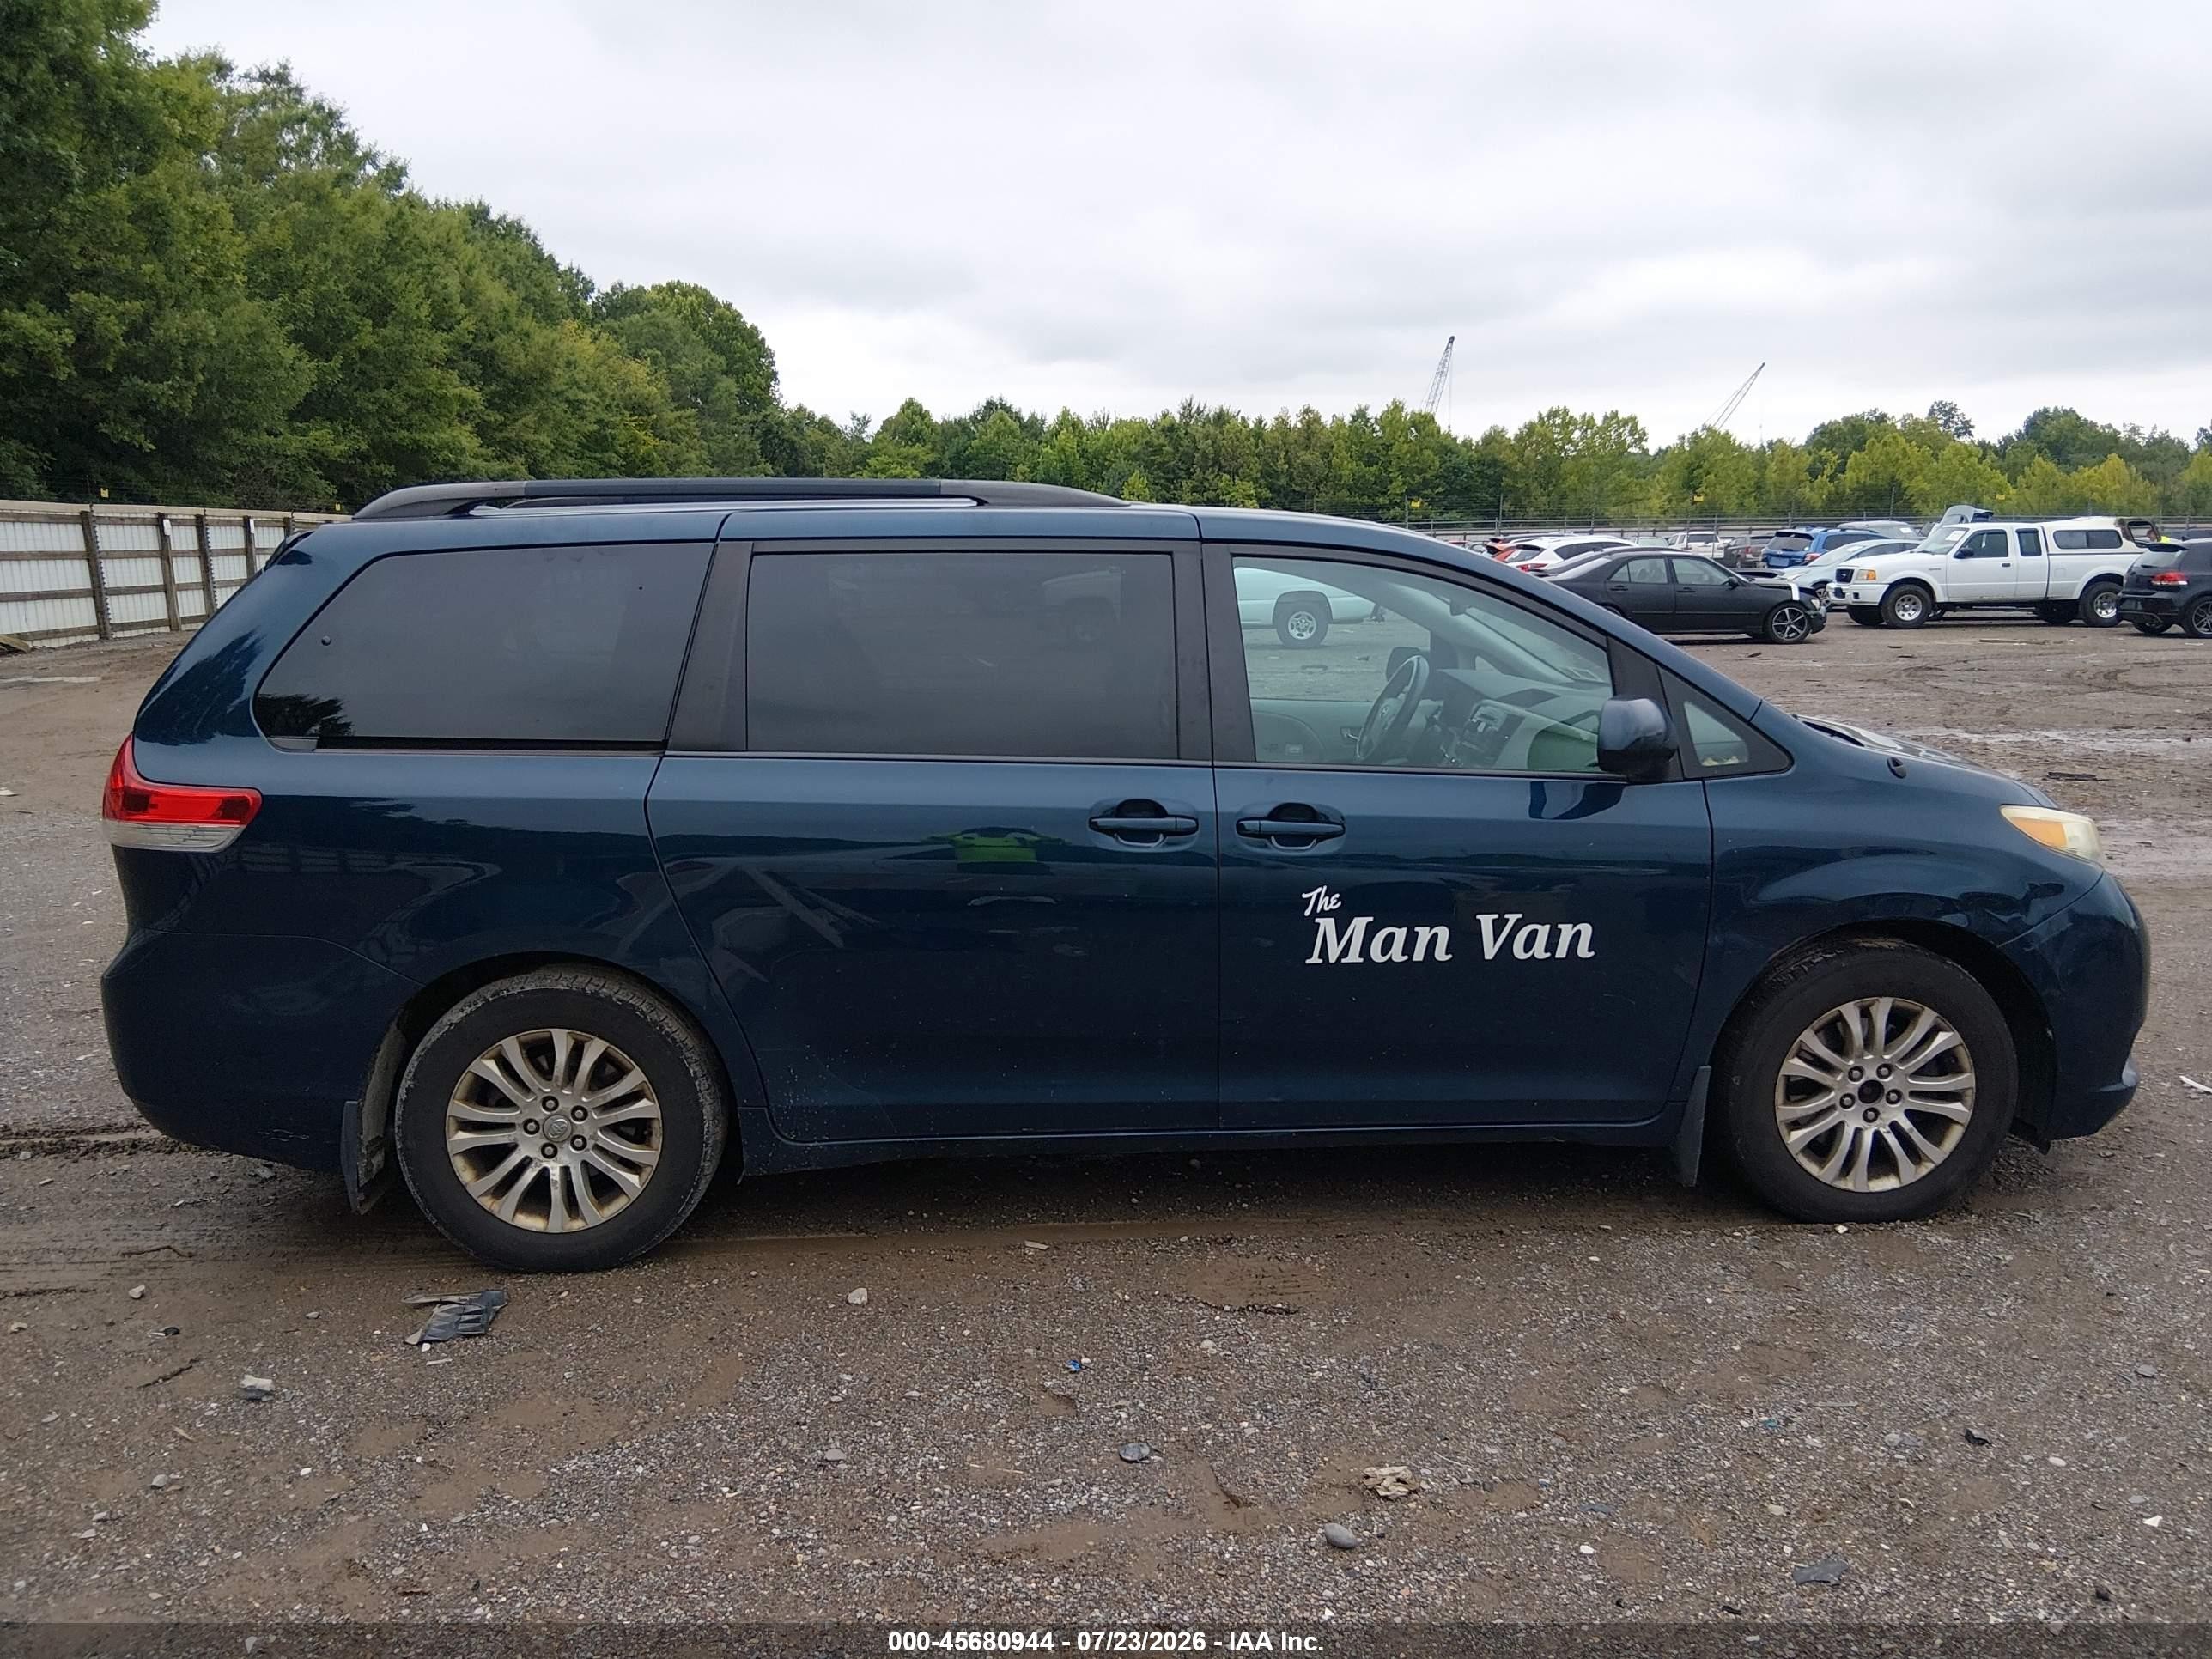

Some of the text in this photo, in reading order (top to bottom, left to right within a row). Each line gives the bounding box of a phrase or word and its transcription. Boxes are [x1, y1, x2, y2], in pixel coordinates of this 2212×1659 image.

[1301, 885, 1342, 916] The
[1304, 913, 1595, 964] Man Van
